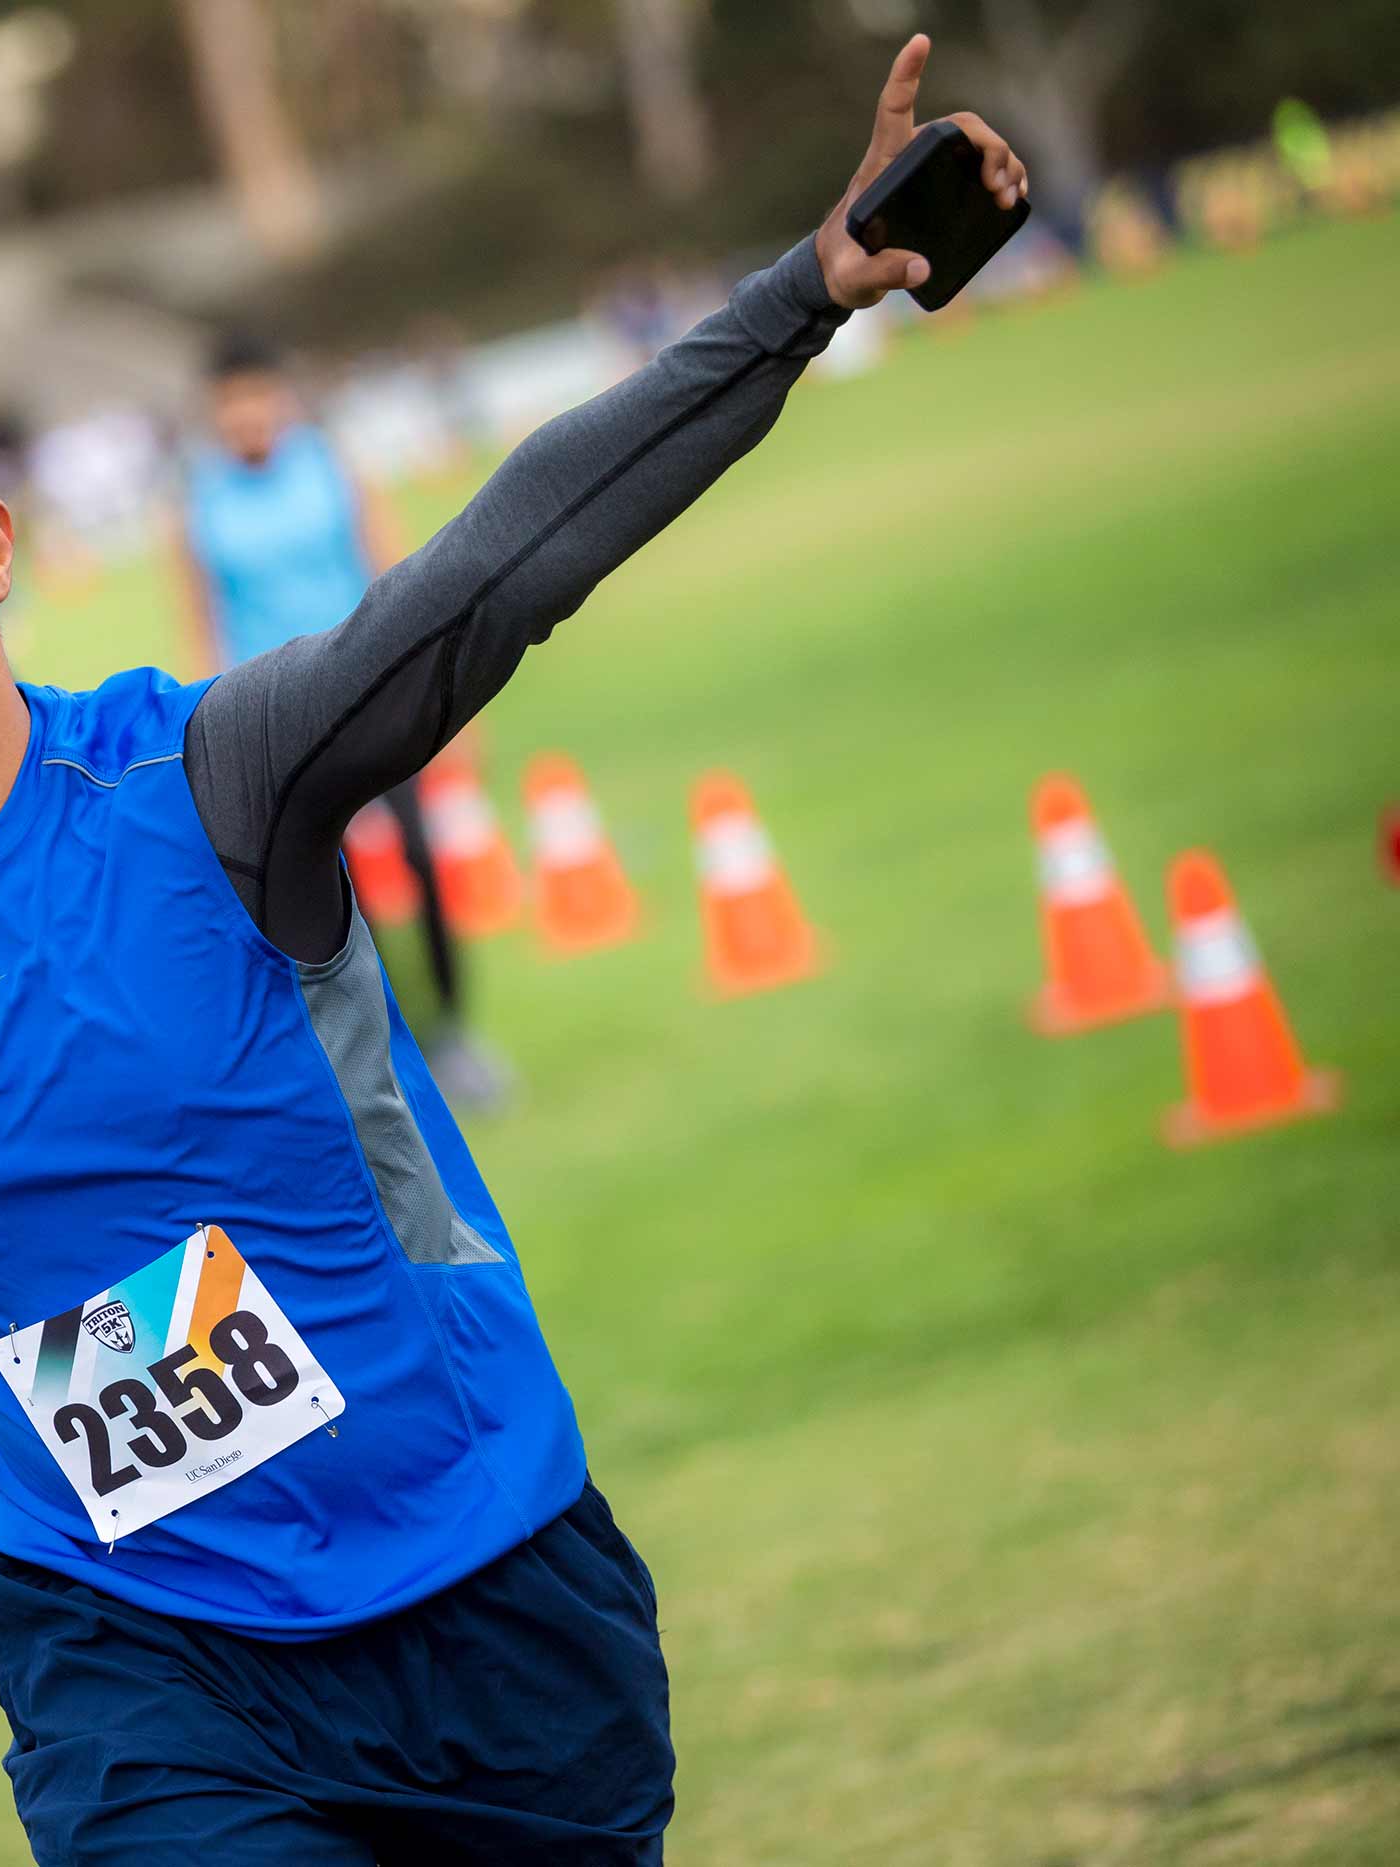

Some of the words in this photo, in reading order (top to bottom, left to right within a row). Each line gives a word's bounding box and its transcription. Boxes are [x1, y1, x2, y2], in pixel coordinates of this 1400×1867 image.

[85, 1304, 126, 1330] TRITON
[100, 1317, 122, 1334] 5K
[53, 1310, 300, 1497] 2358
[185, 1468, 202, 1482] UC
[199, 1463, 218, 1475] San
[214, 1449, 242, 1467] Diego
